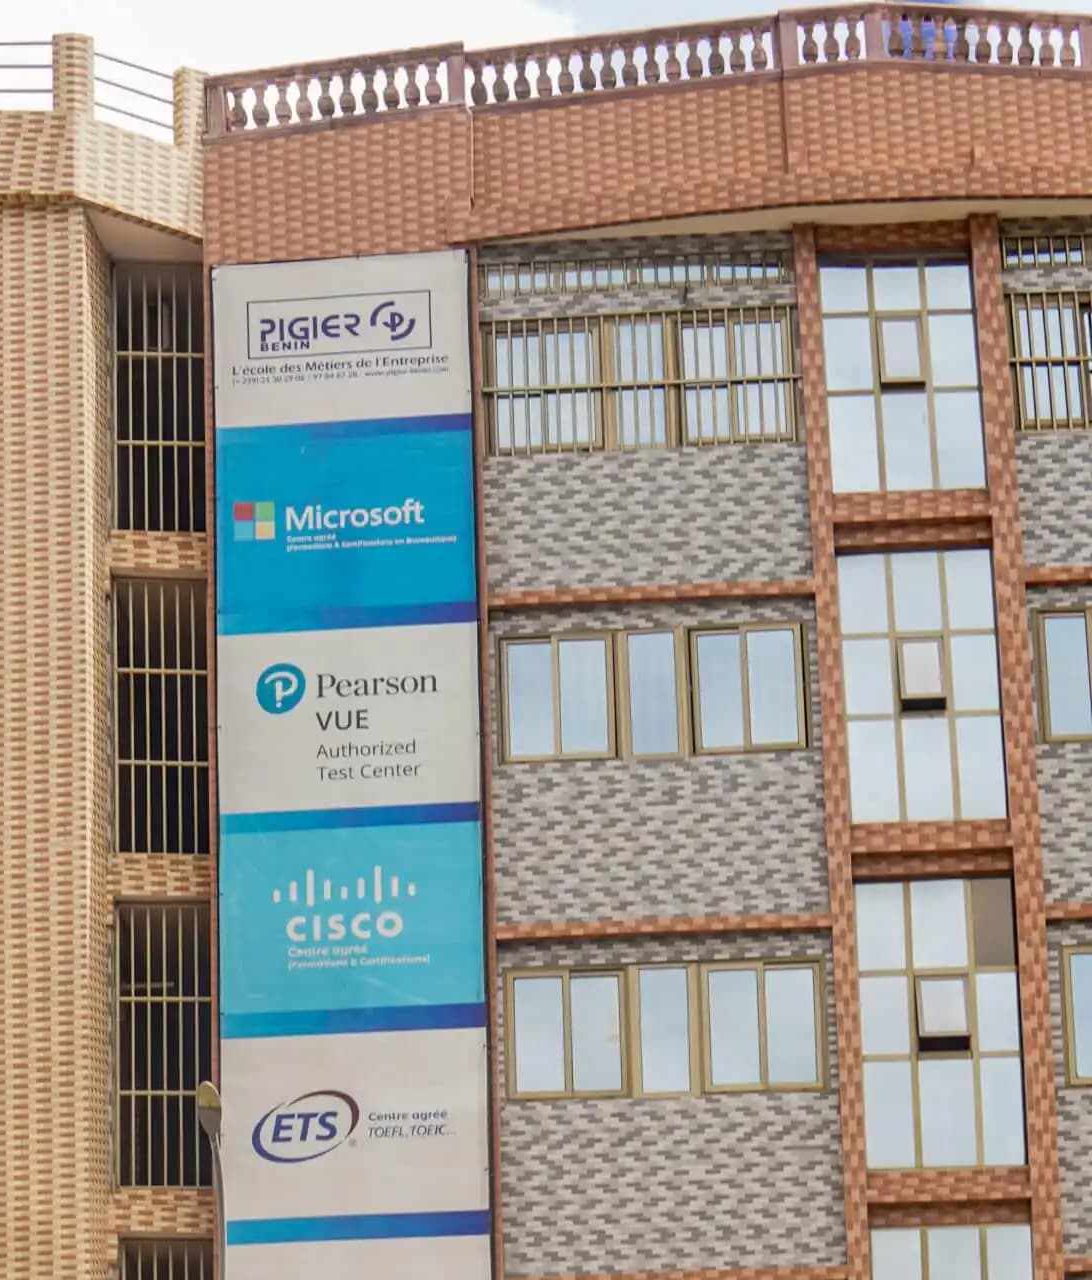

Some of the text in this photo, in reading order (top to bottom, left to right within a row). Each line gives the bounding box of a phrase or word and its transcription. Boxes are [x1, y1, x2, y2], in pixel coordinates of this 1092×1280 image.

[260, 313, 361, 342] PIGIER
[260, 340, 310, 352] BENIN
[232, 354, 449, 375] L'école des Métiers de l'Entreprise
[285, 497, 425, 531] Microsoft
[316, 673, 438, 698] Pearson
[316, 709, 369, 731] VUE
[316, 738, 416, 759] Authorized
[316, 763, 421, 781] Test Center
[286, 911, 403, 942] CISCO
[272, 1111, 338, 1143] ETS
[368, 1109, 447, 1124] Centre agréé
